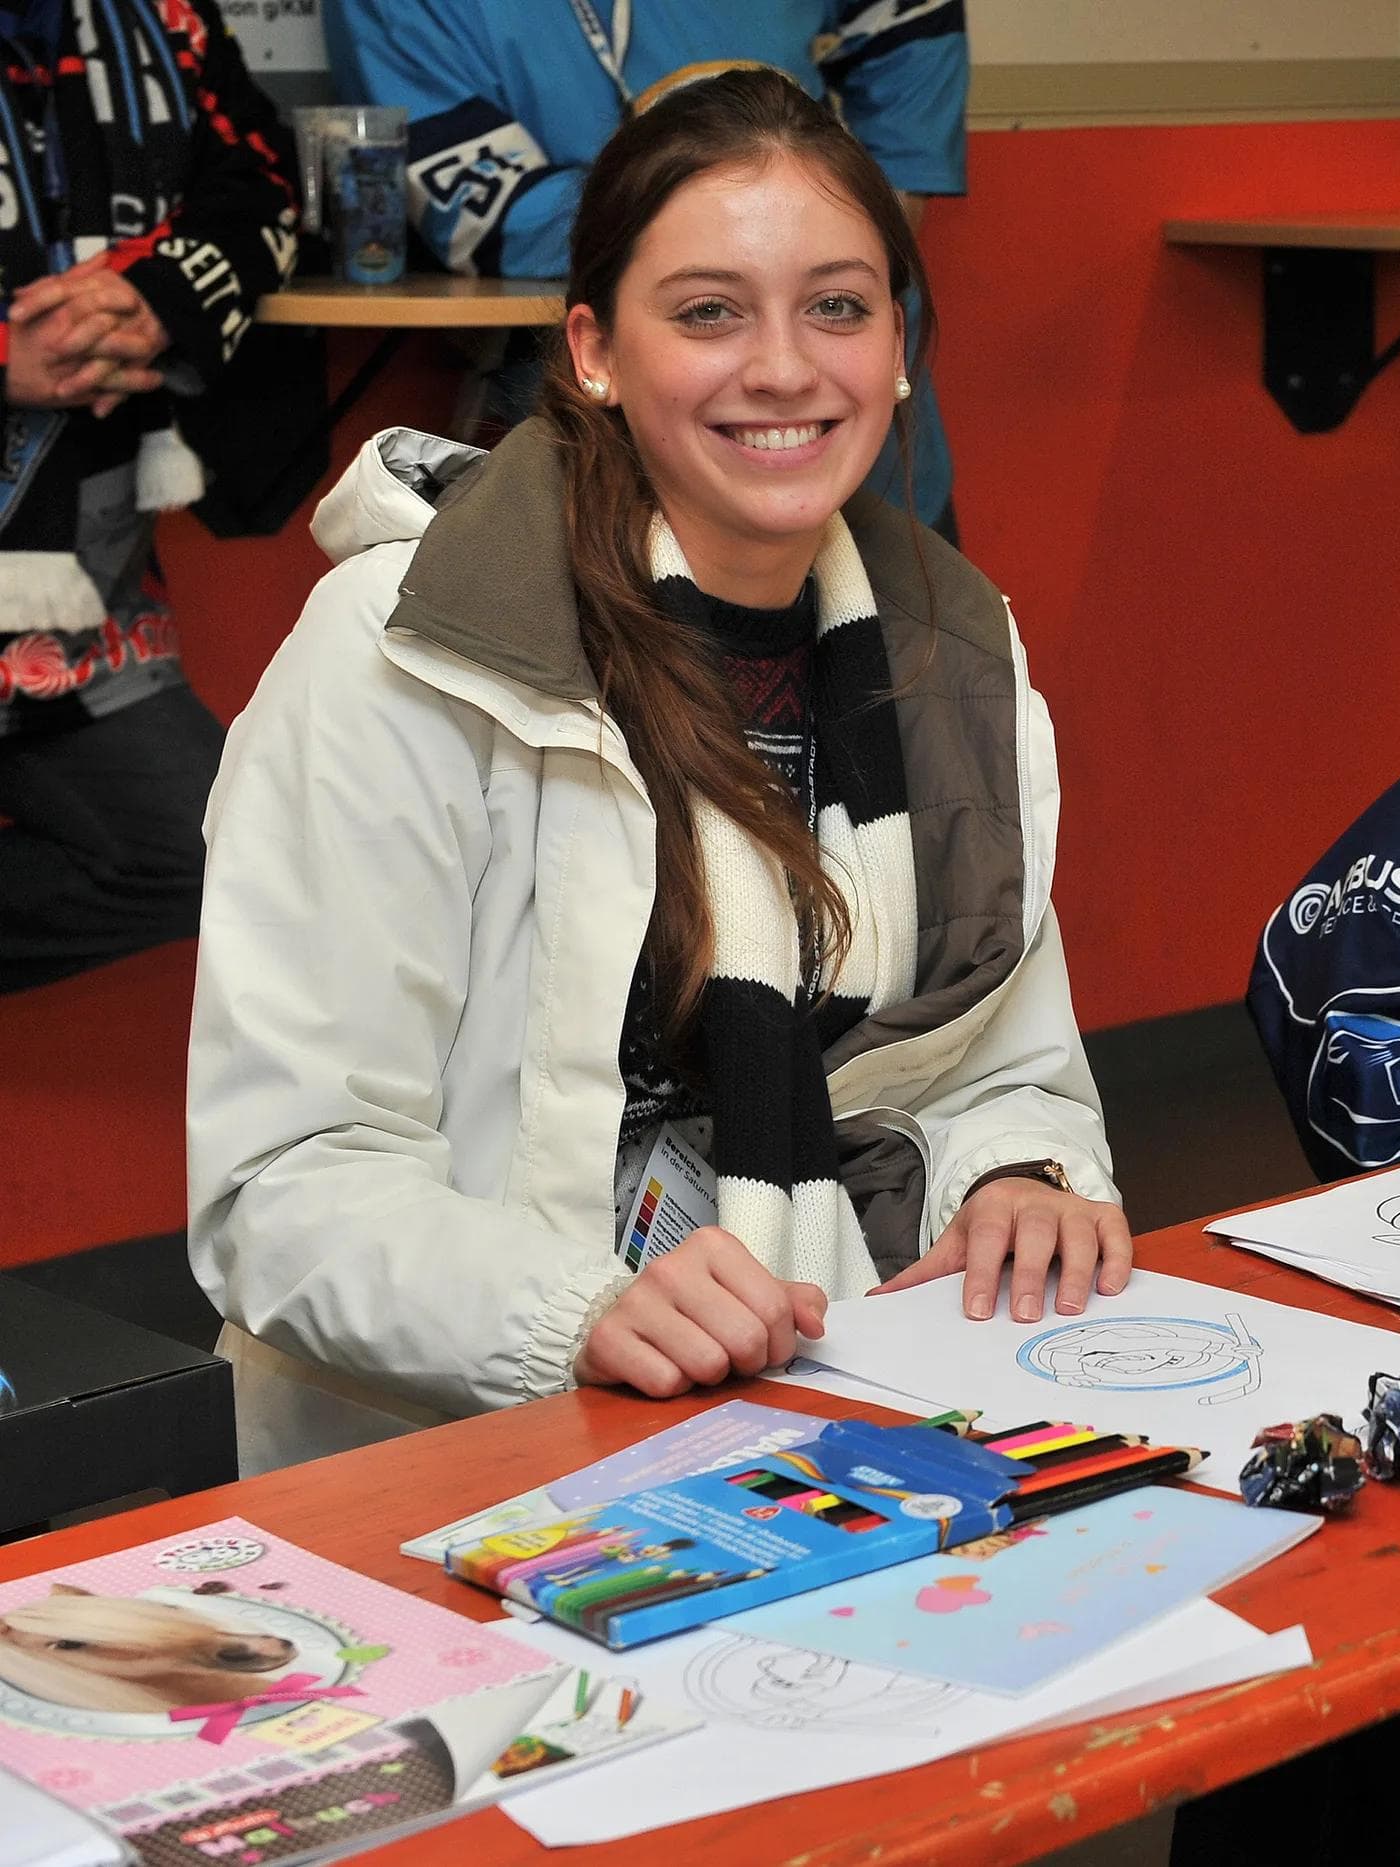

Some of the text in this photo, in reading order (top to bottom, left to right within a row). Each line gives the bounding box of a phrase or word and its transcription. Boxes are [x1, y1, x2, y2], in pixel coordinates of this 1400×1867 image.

[157, 236, 242, 311] SEIT
[661, 1147, 669, 1158] in
[669, 1154, 684, 1173] der
[683, 1170, 710, 1201] Saturn
[665, 1137, 702, 1178] Bereiche
